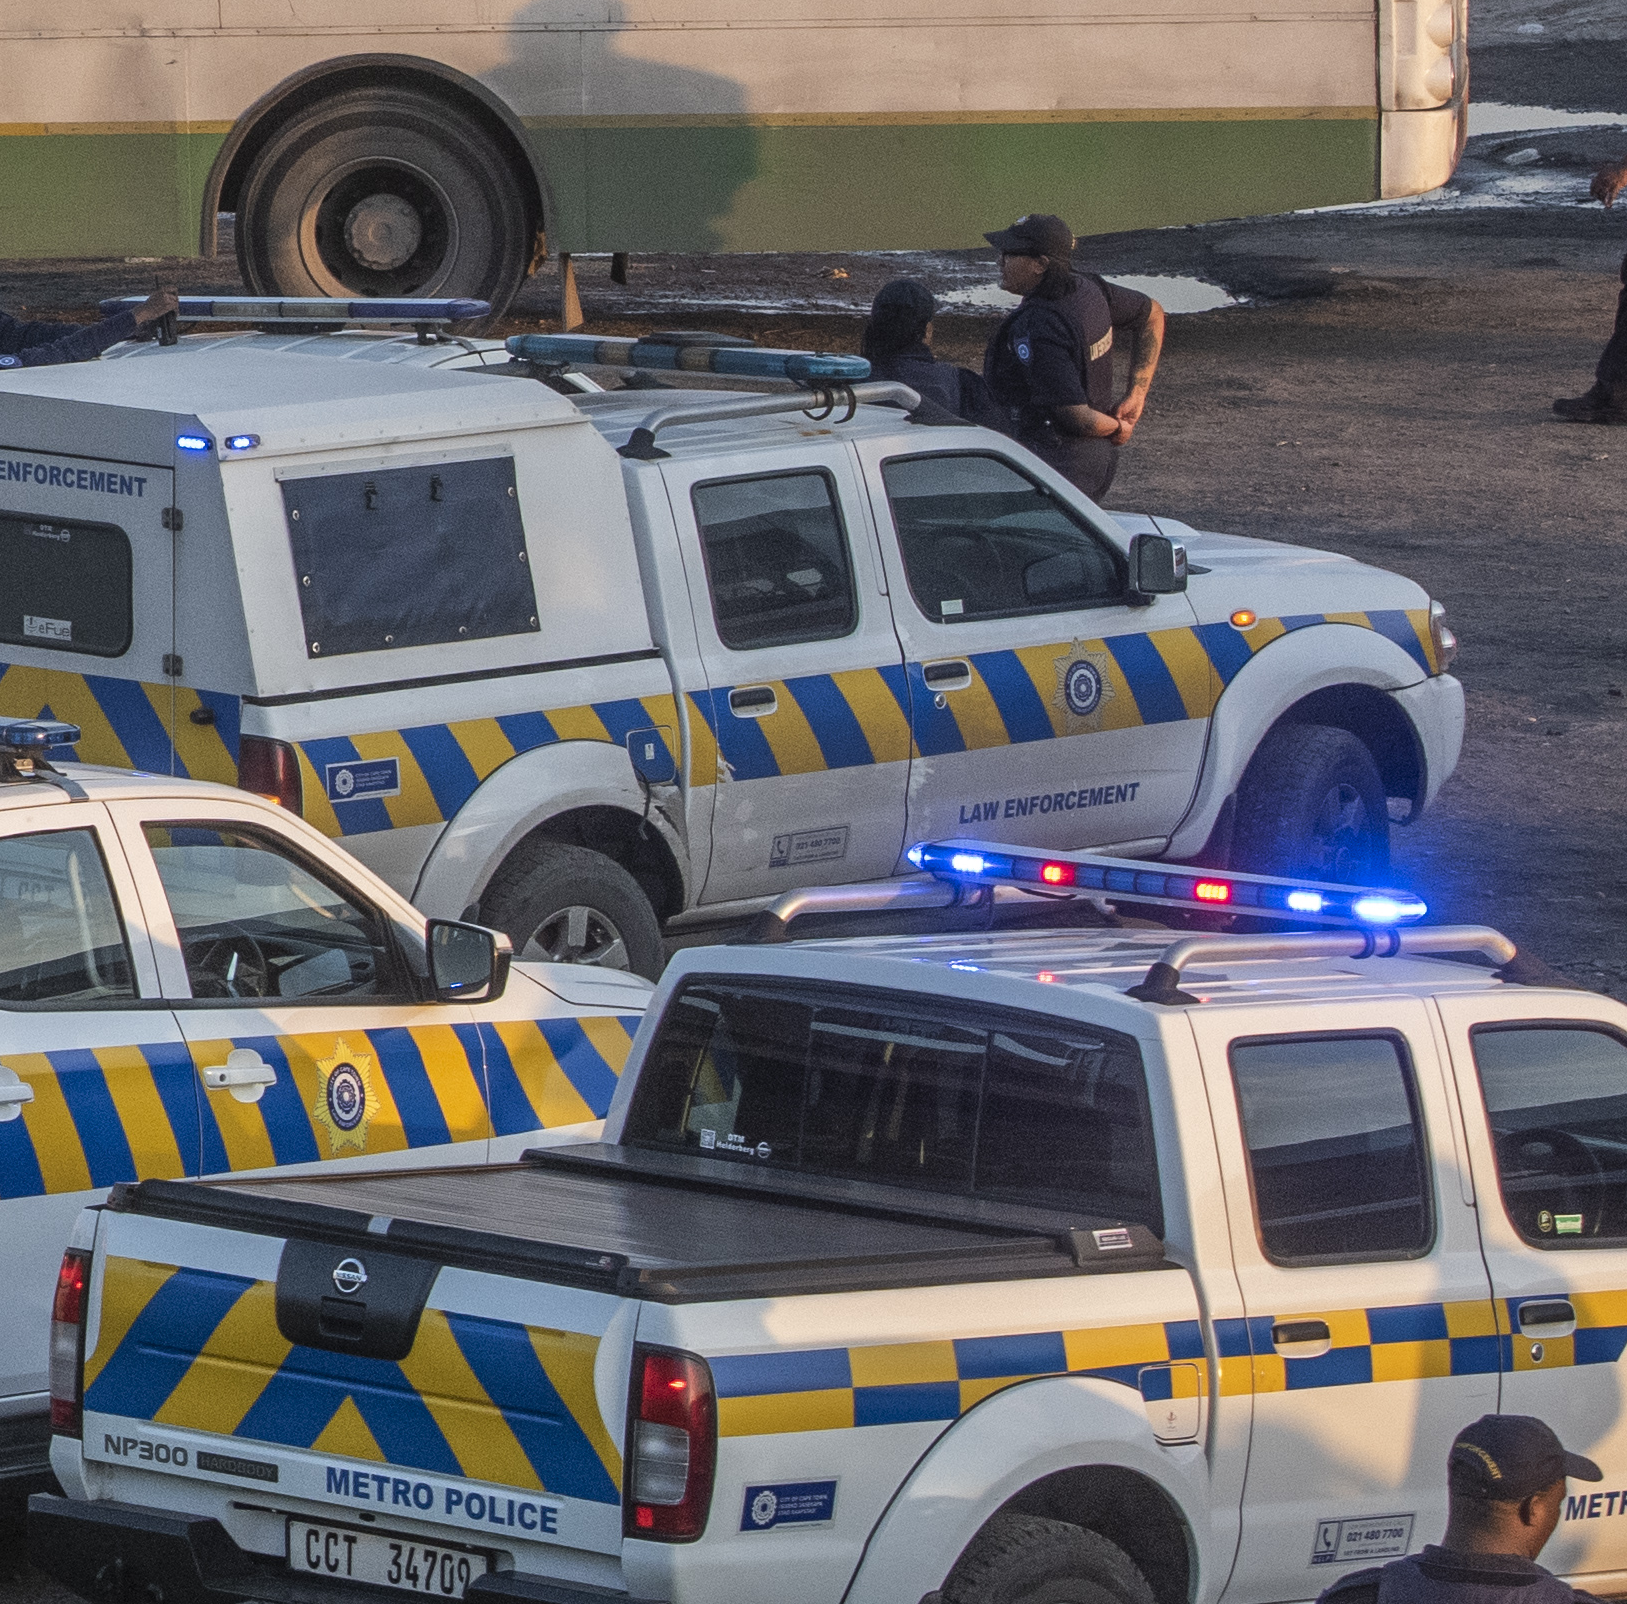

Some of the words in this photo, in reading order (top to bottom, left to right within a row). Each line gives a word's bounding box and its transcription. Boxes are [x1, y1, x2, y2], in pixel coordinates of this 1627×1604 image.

[958, 800, 1001, 825] LAW
[1004, 782, 1140, 820] ENFORCEMENT
[716, 1140, 755, 1156] Helderberg
[727, 1132, 745, 1144] DTM
[103, 1434, 189, 1467] NP300
[325, 1465, 434, 1511] METRO
[444, 1487, 559, 1535] POLICE
[1347, 1532, 1362, 1542] 021
[1364, 1530, 1381, 1540] 480
[1383, 1528, 1404, 1539] 7700
[305, 1528, 357, 1576] CCT
[388, 1542, 472, 1599] 34709
